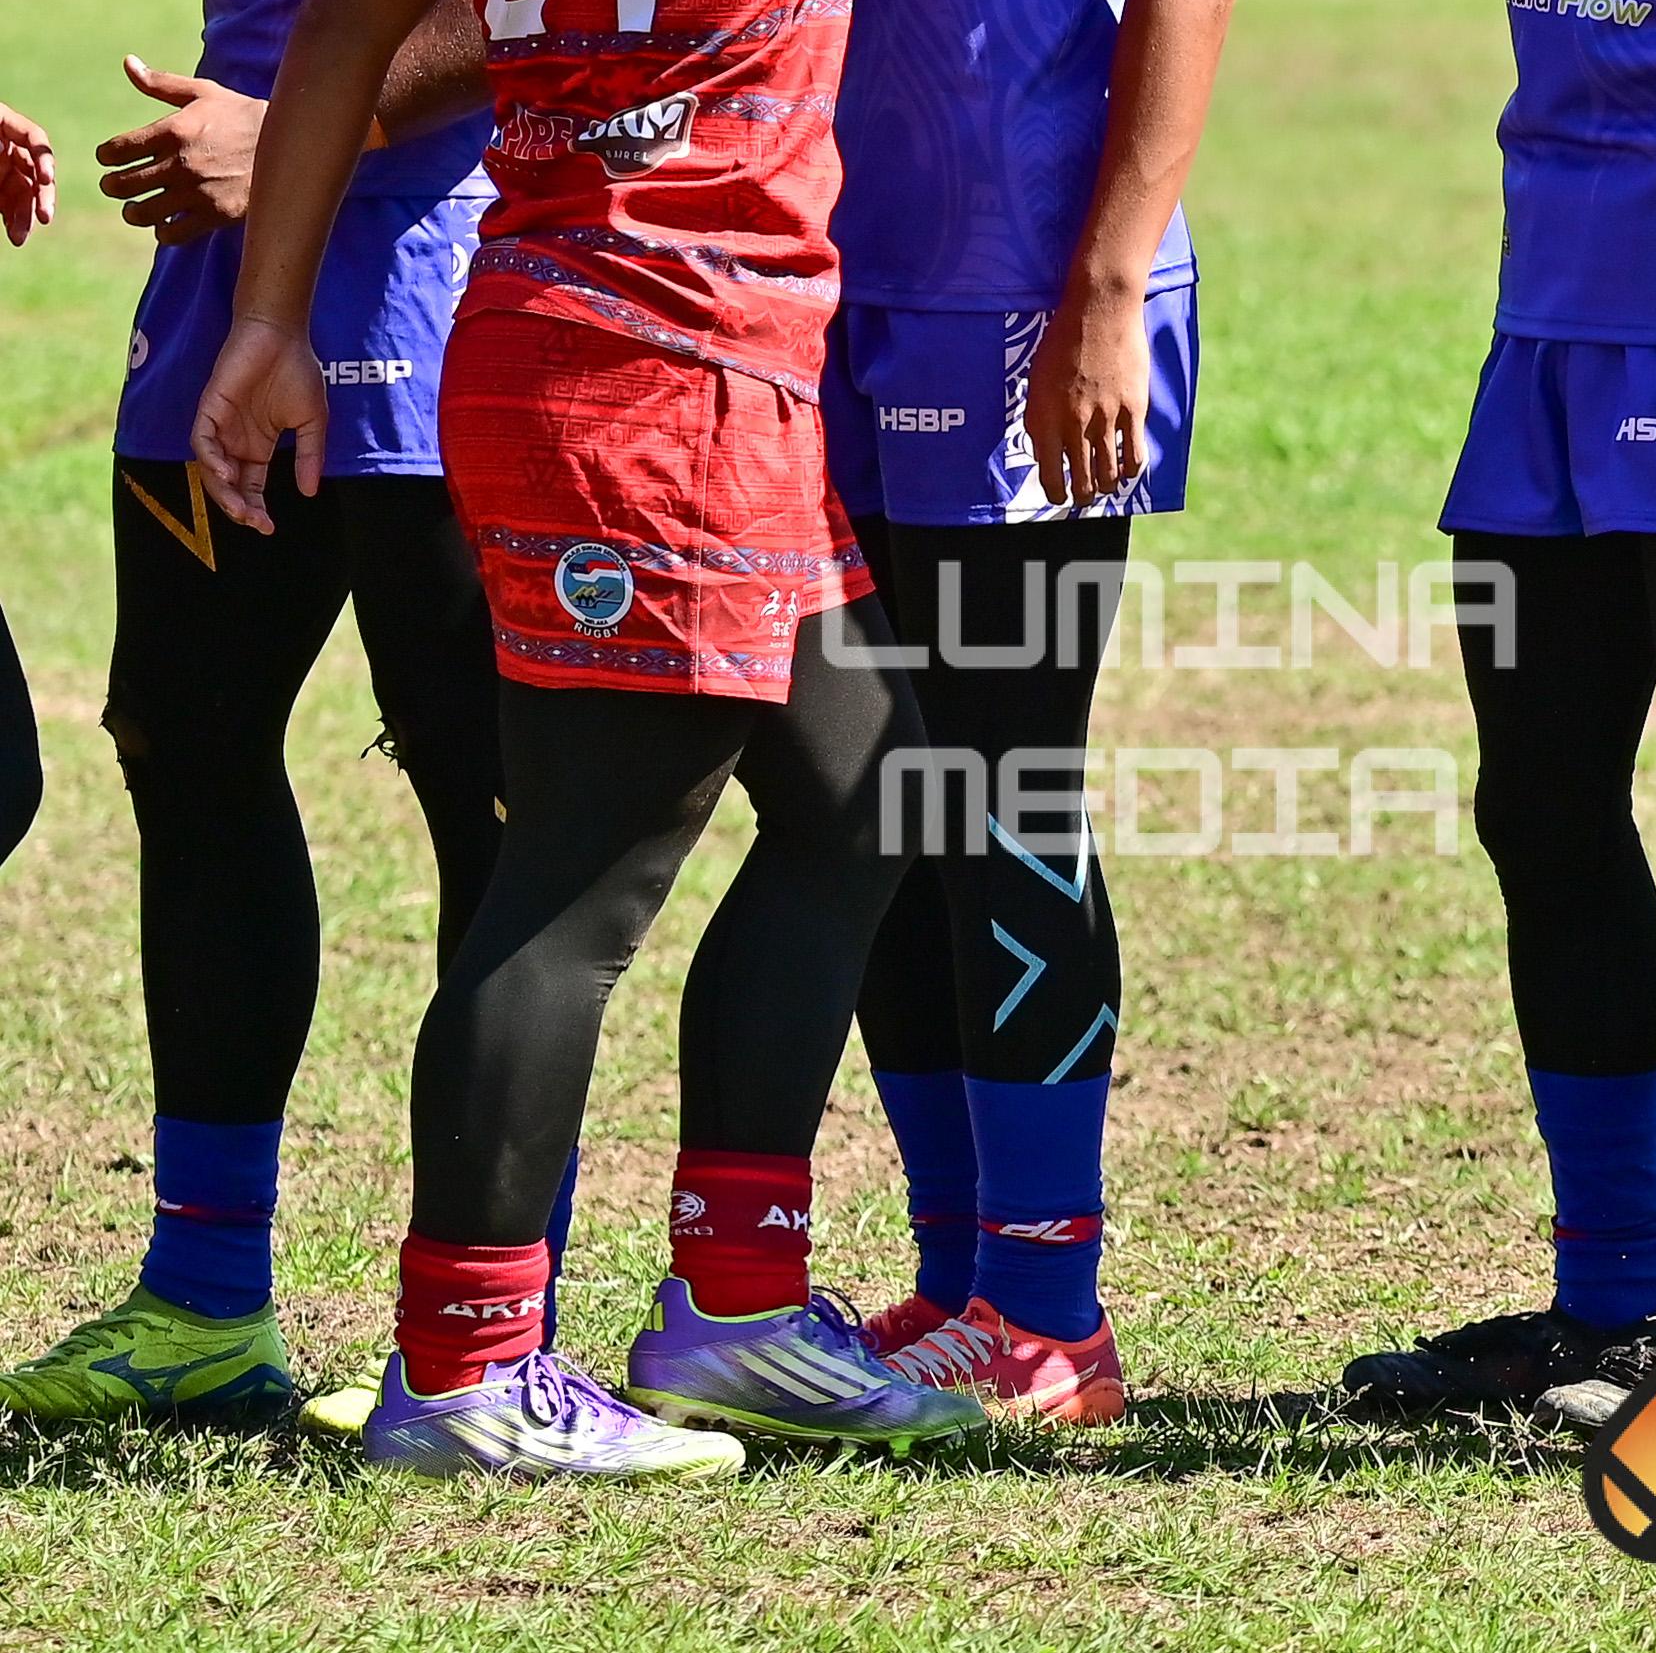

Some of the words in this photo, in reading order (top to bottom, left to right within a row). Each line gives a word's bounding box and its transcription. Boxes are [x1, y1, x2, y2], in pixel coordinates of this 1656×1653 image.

[322, 359, 413, 385] HSBP
[879, 406, 965, 432] HSBP
[573, 622, 619, 638] RUGBY
